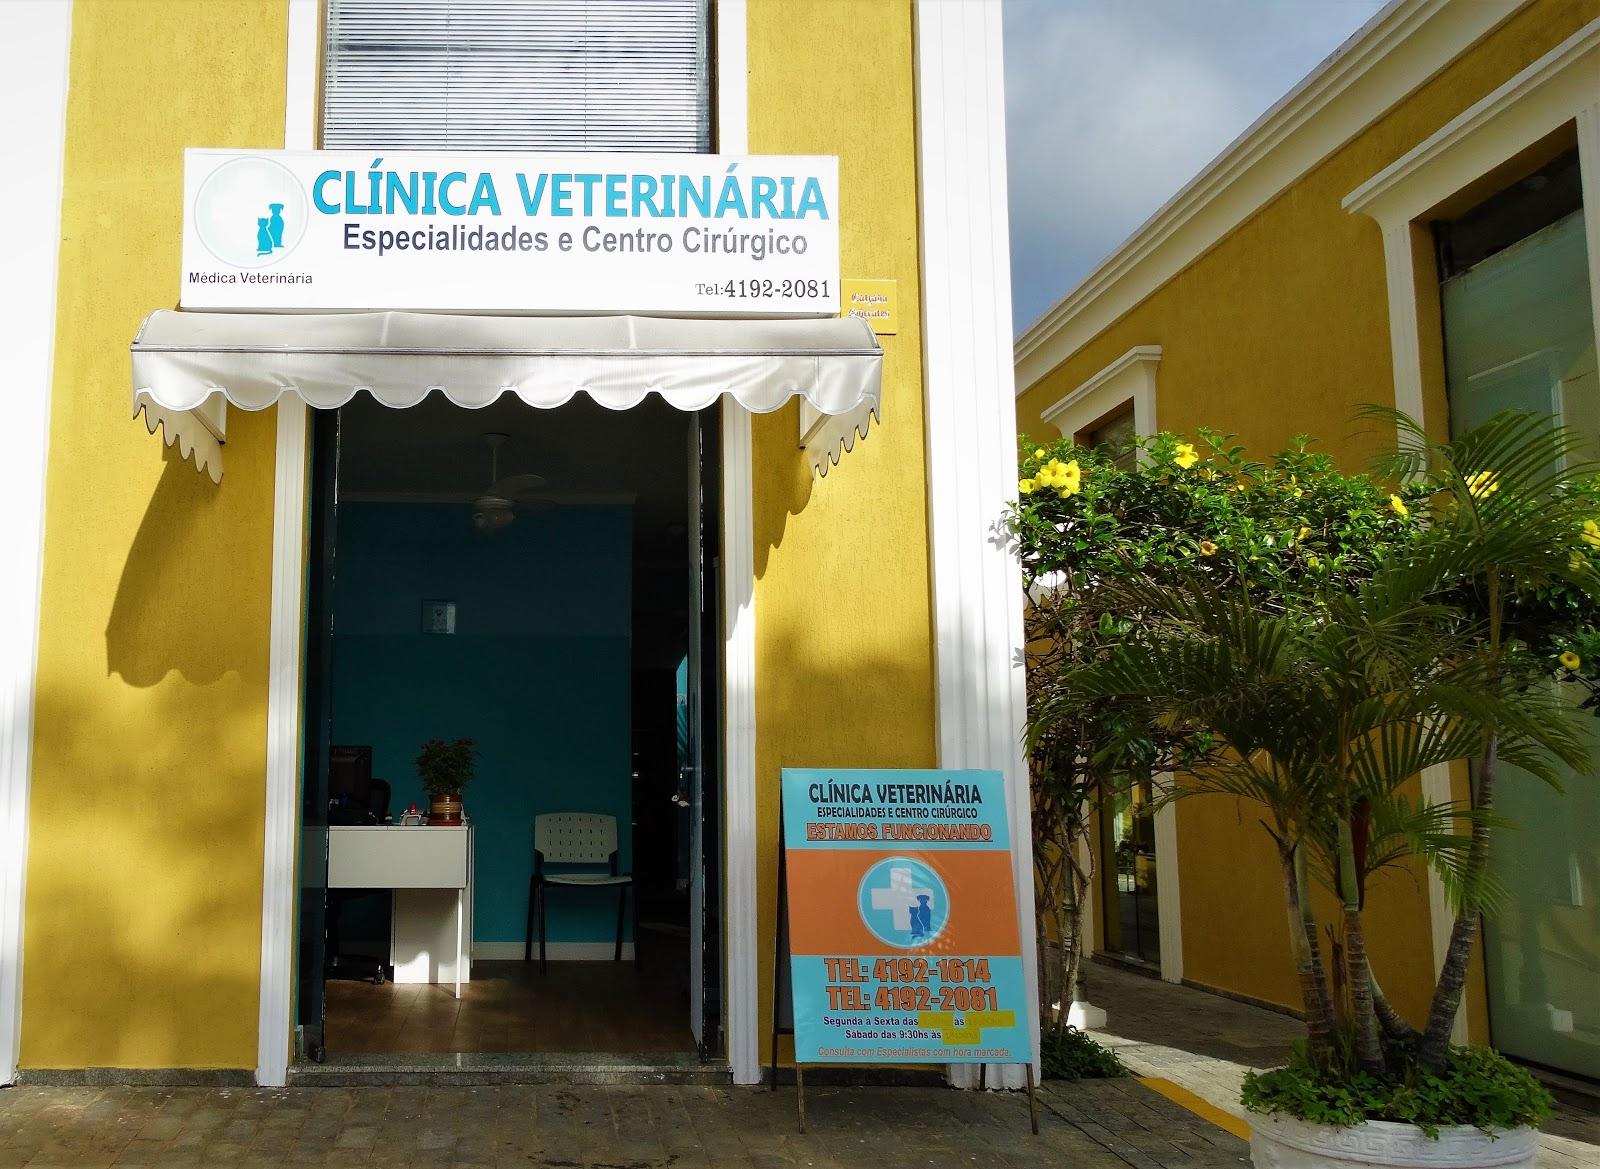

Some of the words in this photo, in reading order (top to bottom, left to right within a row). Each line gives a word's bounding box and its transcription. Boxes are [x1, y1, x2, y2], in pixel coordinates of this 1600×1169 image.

[313, 158, 501, 216] CLÍNICA
[516, 163, 829, 220] VETERINÁRIA
[344, 223, 548, 256] Especialidades
[558, 232, 573, 251] e
[582, 226, 673, 252] Centro
[683, 227, 808, 260] Cirúrgico
[189, 272, 236, 284] Médica
[240, 272, 313, 284] Veterinária
[695, 280, 830, 298] Tel:4192-2081
[808, 779, 873, 804] CLÍNICA
[876, 780, 983, 804] VETERINÁRIA
[817, 807, 886, 818] ESPECIALIDADES
[888, 808, 893, 818] E
[895, 808, 929, 818] CENTRO
[931, 805, 978, 819] CIRÚRGICO
[807, 823, 878, 840] ESTAMOS
[882, 823, 992, 840] FUNCIONANDO
[824, 958, 870, 982] TEL:
[873, 958, 991, 983] 4192-1614
[826, 986, 871, 1011] TEL:
[875, 986, 998, 1011] 4192-2081
[823, 1016, 863, 1027] Segunda
[874, 1017, 900, 1026] Sexta
[902, 1017, 919, 1026] das
[954, 1017, 965, 1026] às
[845, 1030, 879, 1039] Sábado
[881, 1030, 897, 1039] das
[899, 1030, 929, 1039] 9:30hs
[931, 1030, 942, 1039] às
[818, 1047, 855, 1057] Consulta
[857, 1048, 875, 1057] com
[877, 1047, 931, 1058] Especialistas
[933, 1048, 951, 1057] com
[953, 1048, 973, 1057] hora
